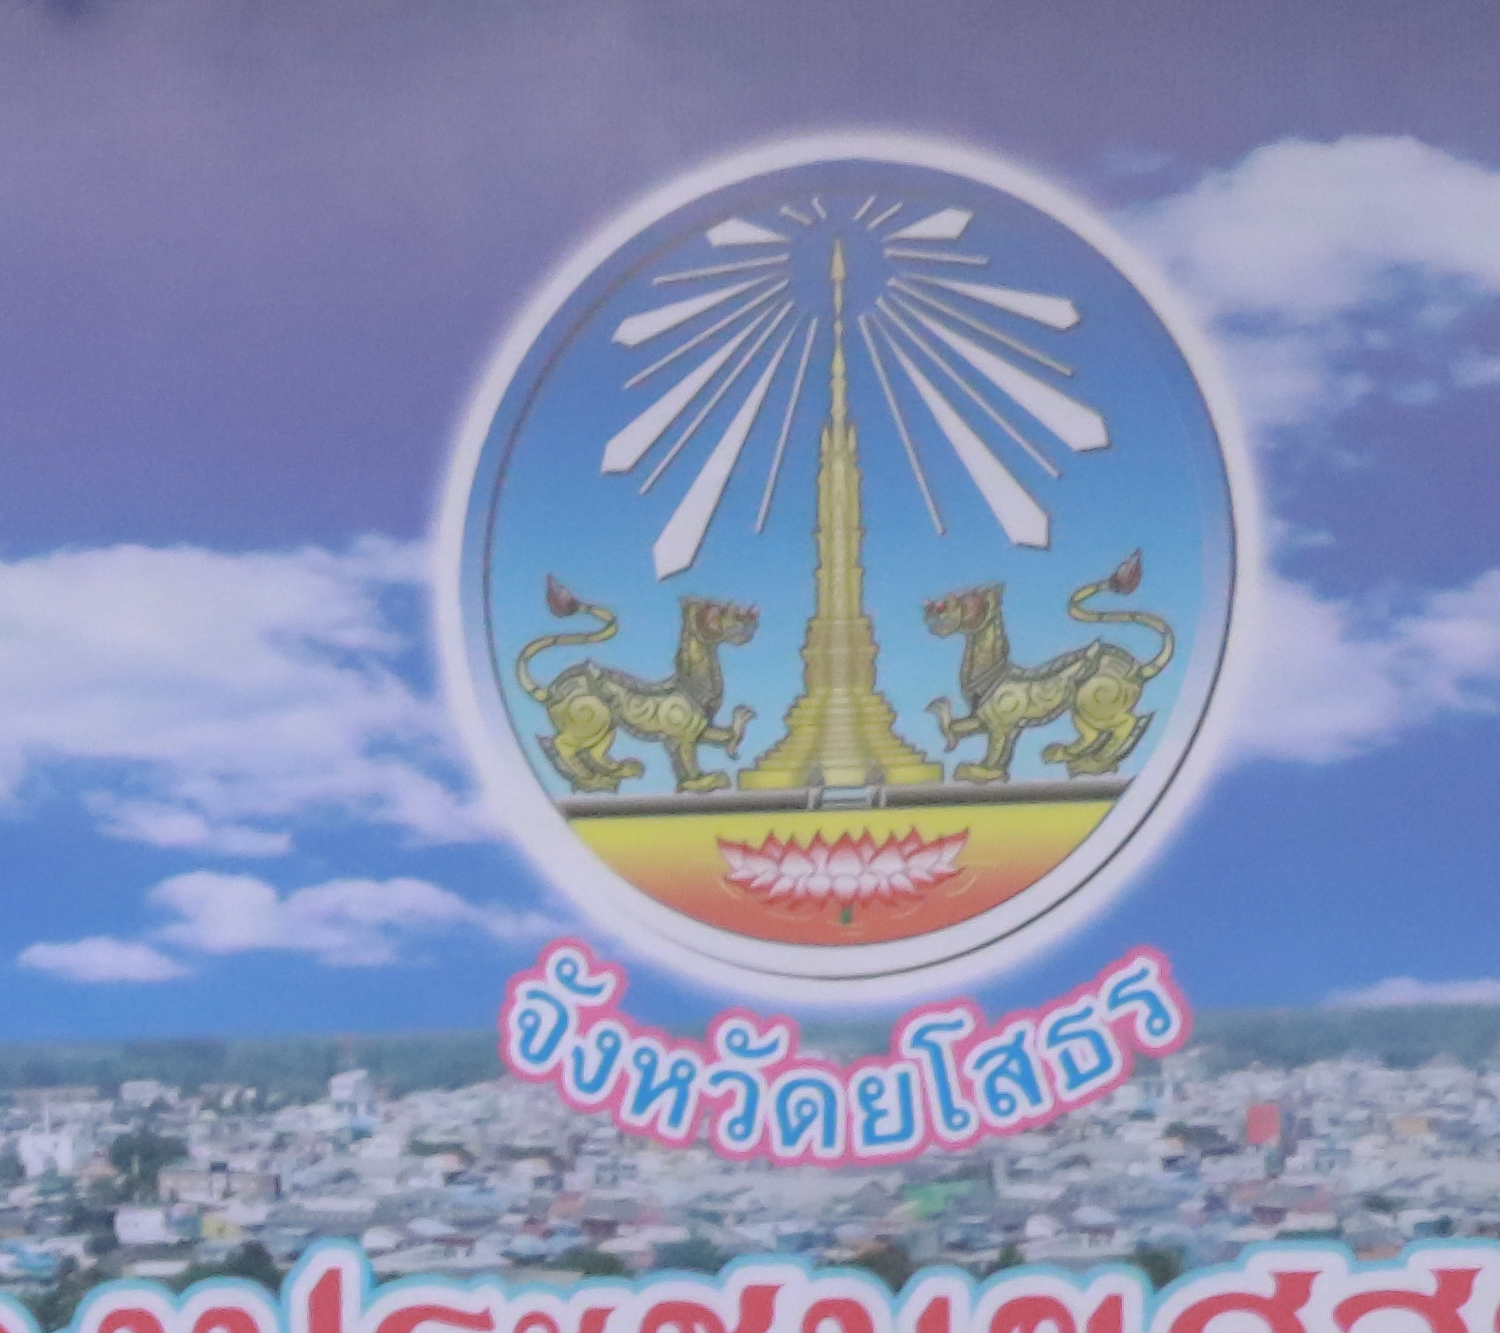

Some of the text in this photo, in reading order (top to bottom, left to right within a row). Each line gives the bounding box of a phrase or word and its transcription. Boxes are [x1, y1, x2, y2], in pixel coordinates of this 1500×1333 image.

[508, 940, 1184, 1156] จังหวัดยโสธร
